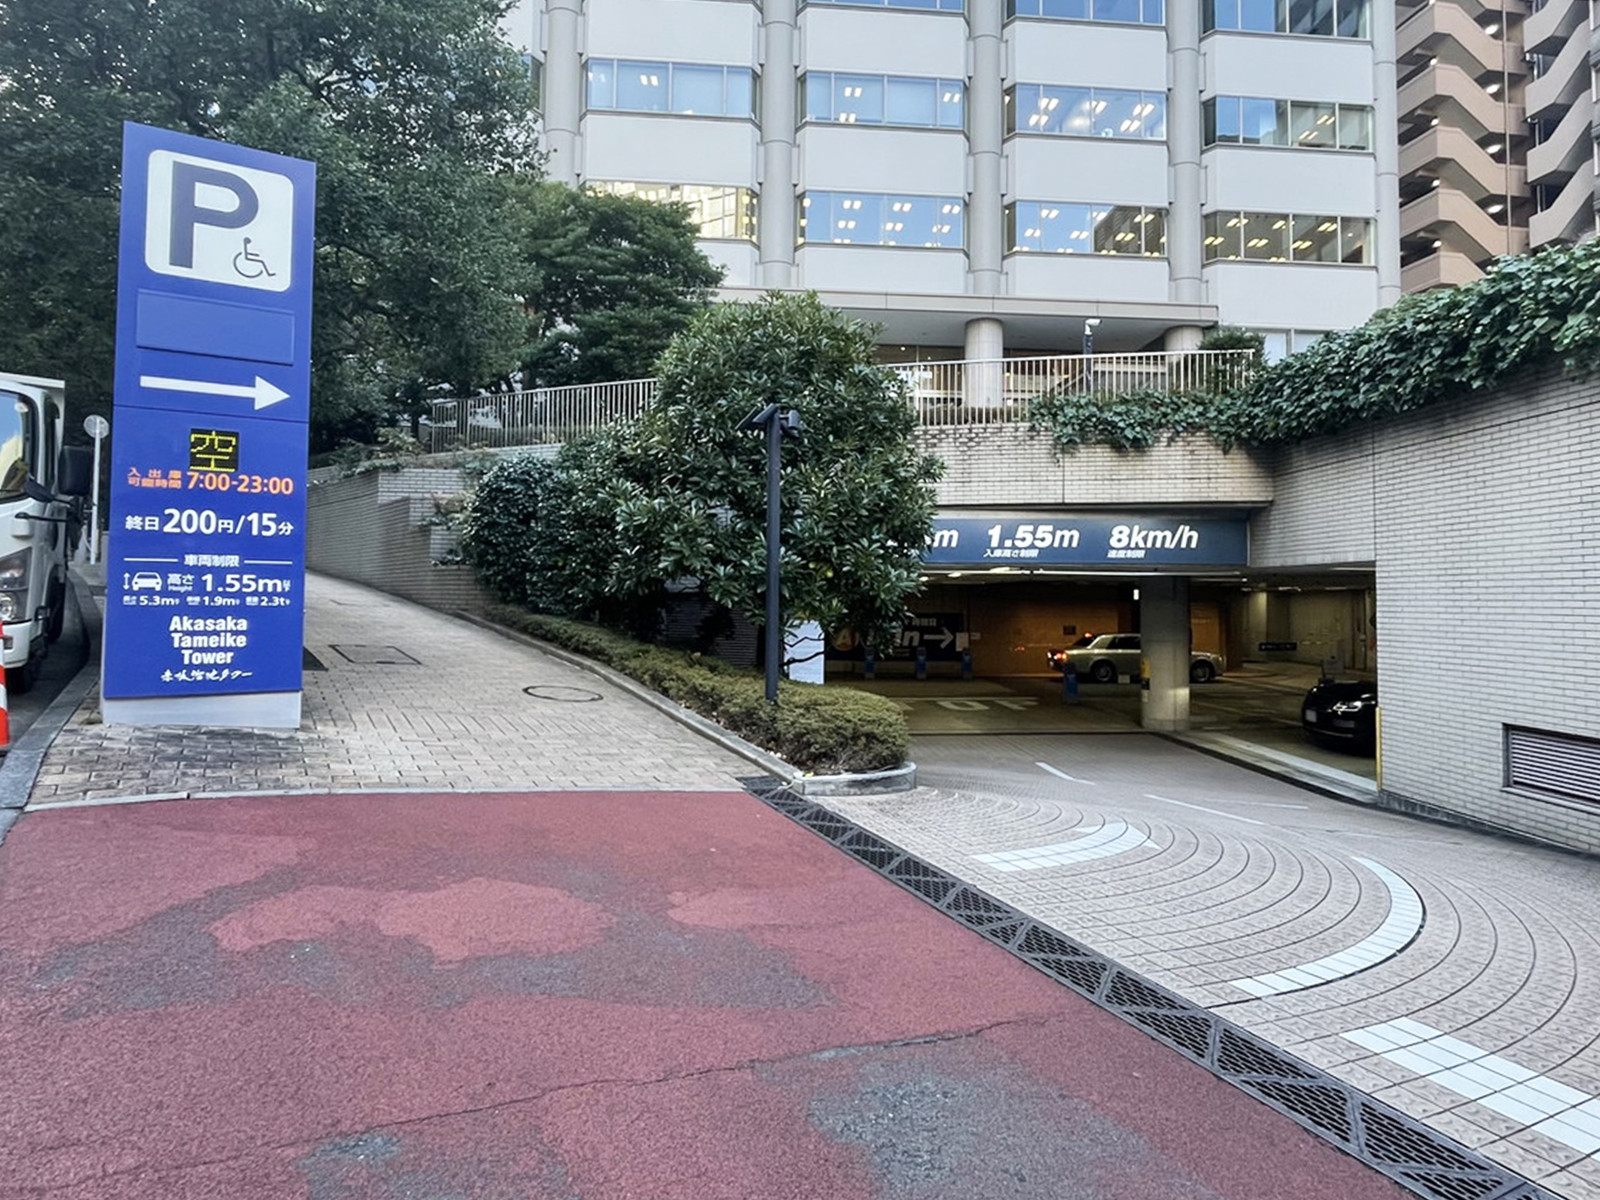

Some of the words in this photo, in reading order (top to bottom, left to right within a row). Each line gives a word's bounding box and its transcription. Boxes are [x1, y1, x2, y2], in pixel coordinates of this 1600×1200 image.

[169, 160, 259, 269] P
[190, 430, 236, 472] 空
[187, 471, 294, 495] 7:00-23:00
[125, 515, 160, 531] 終日
[987, 524, 1080, 548] 1.55m
[1109, 524, 1199, 549] 8km/h
[184, 553, 240, 567] 車両制限
[167, 573, 195, 585] 高さ
[201, 573, 281, 593] 1.55m
[139, 595, 174, 606] 5.3m
[203, 596, 235, 606] 1.9m
[260, 596, 286, 606] 2.3t
[169, 615, 248, 631] Akasaka
[171, 632, 247, 648] Tameike
[181, 649, 235, 665] Tower
